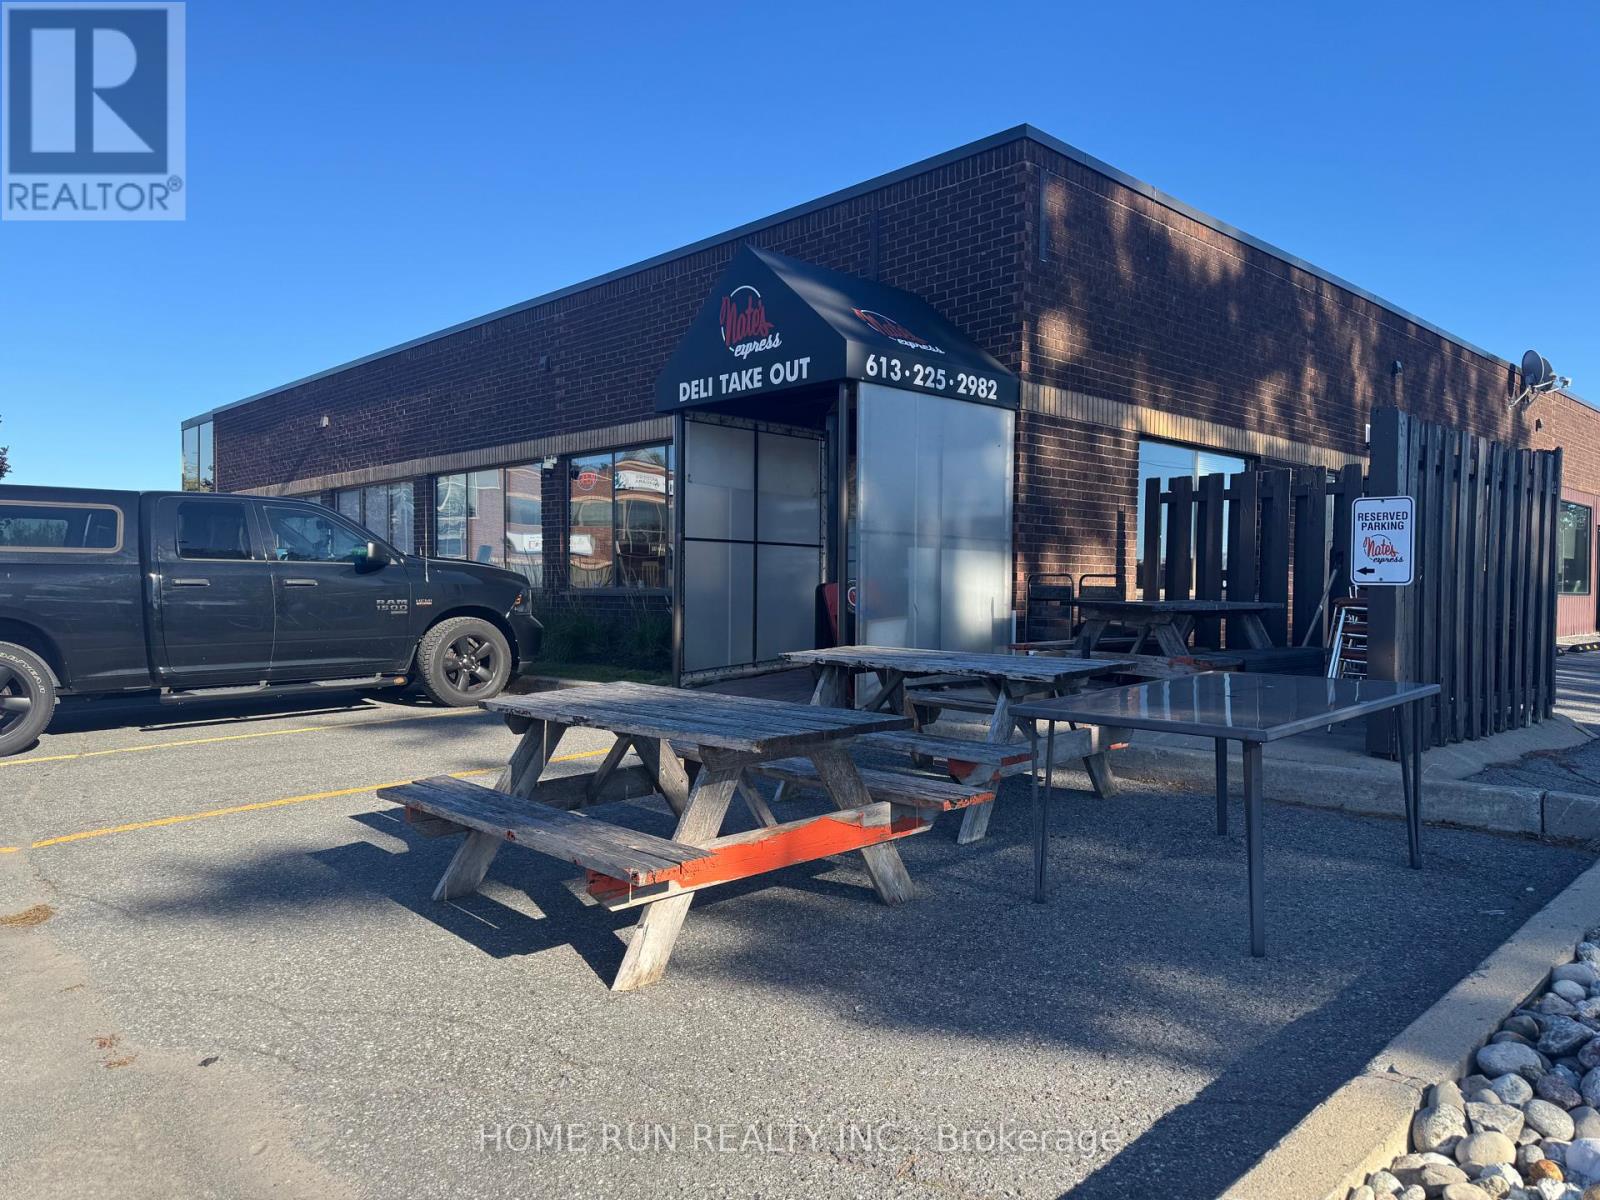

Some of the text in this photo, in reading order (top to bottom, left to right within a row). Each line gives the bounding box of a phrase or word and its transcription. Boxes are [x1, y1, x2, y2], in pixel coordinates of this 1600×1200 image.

[734, 332, 782, 360] express
[679, 357, 811, 402] DELI TAKE OUT
[1357, 511, 1408, 521] RESERVED
[1361, 521, 1404, 531] PARKING
[1373, 556, 1404, 564] express
